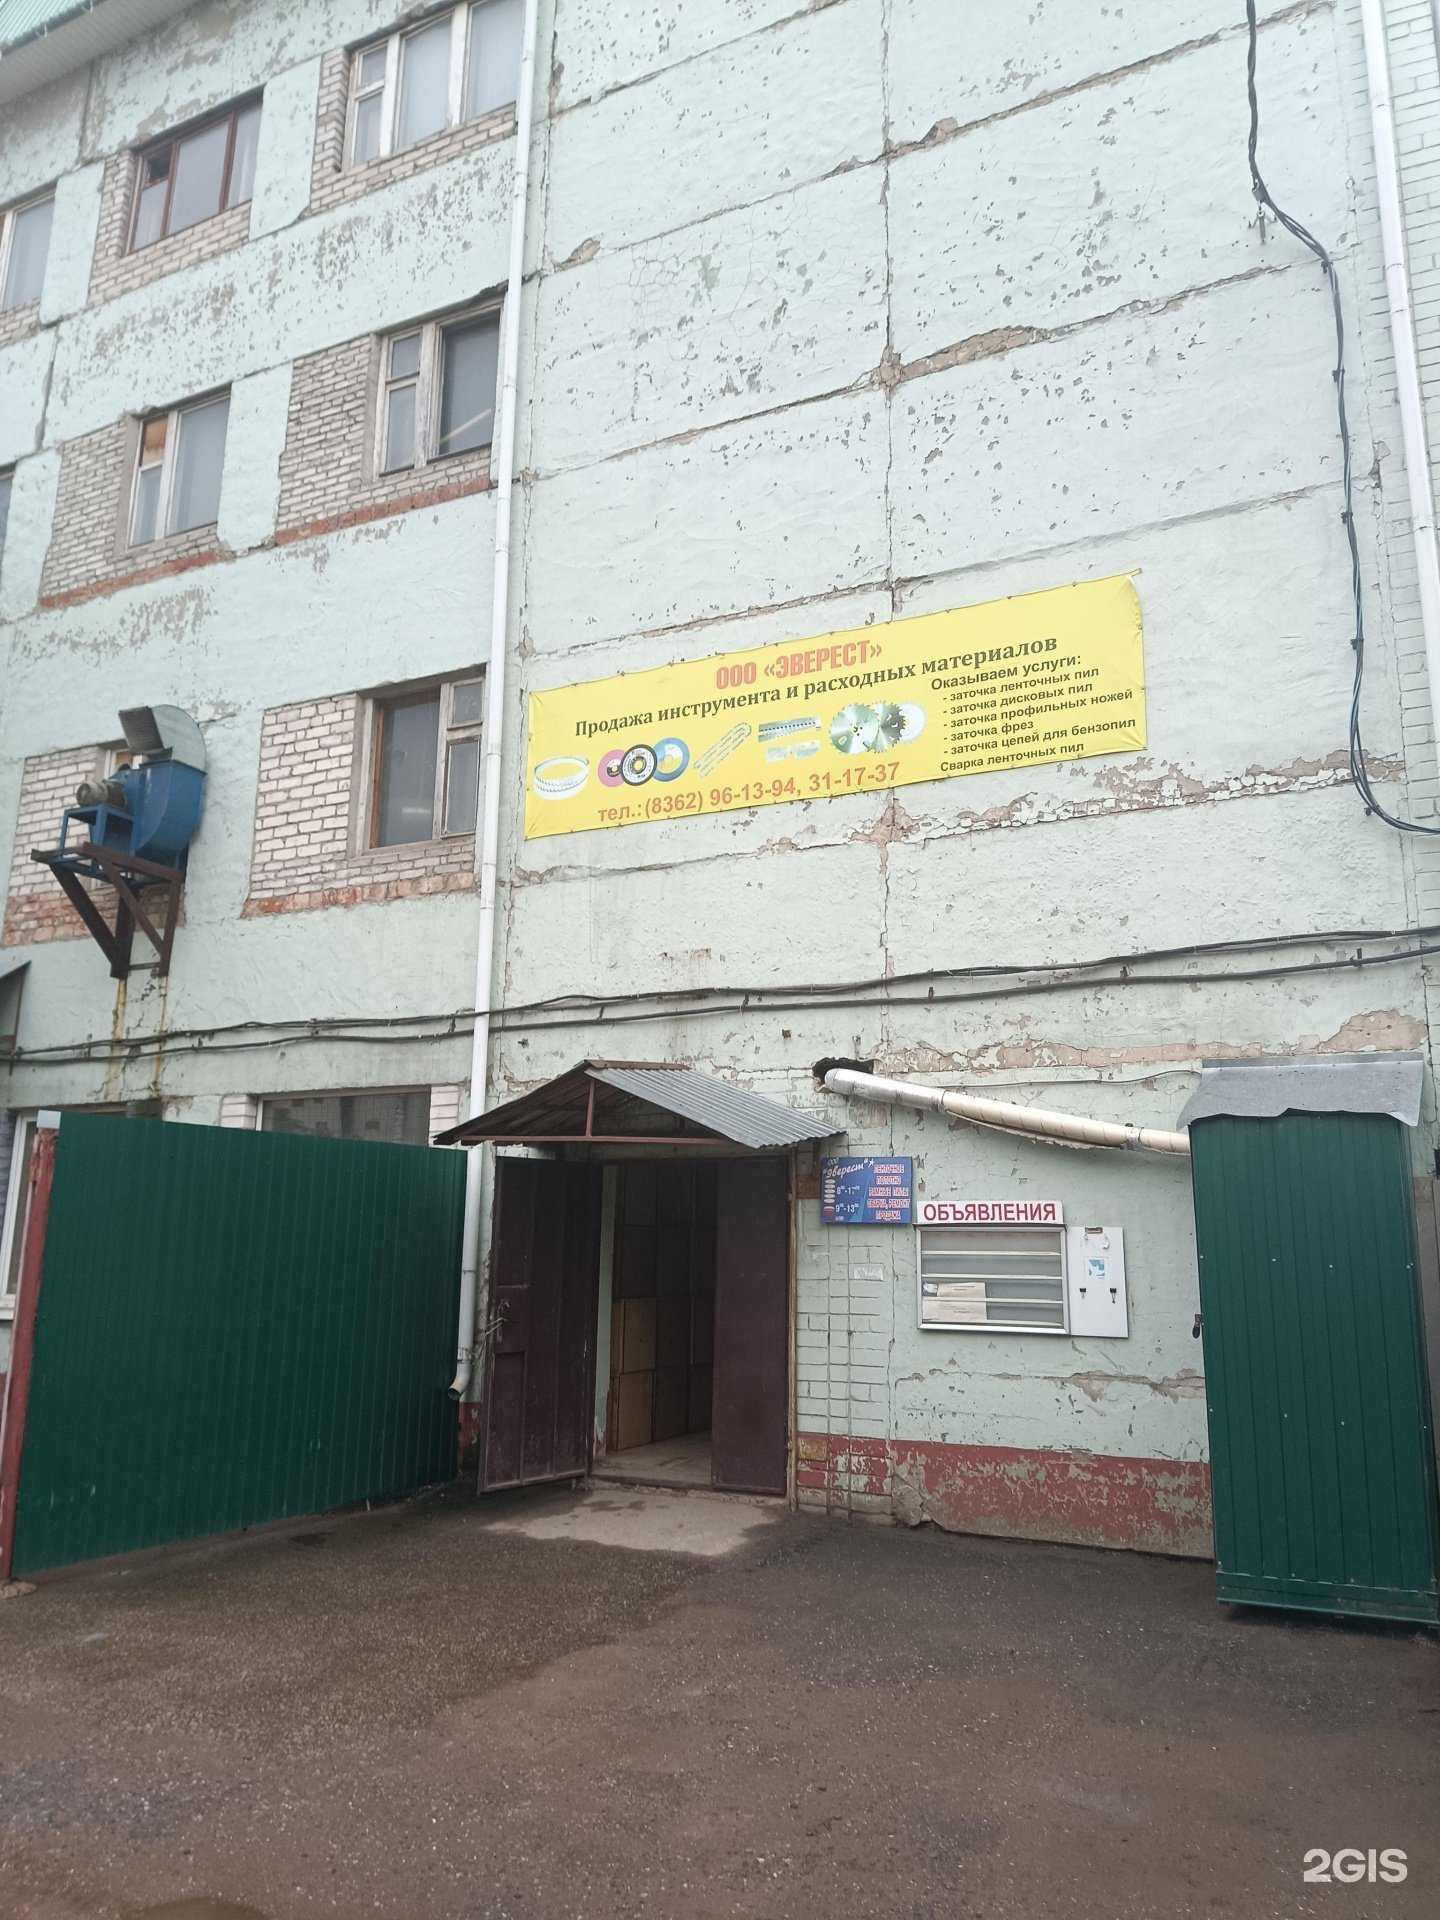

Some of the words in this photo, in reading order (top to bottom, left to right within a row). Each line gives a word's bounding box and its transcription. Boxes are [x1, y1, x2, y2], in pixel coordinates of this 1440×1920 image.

[716, 662, 757, 690] ООО
[764, 640, 882, 679] «ЭВЕРЕСТ»
[931, 666, 1018, 691] Оказываем
[1023, 655, 1082, 679] услуги:
[575, 711, 653, 738] Продажа
[658, 687, 781, 719] инструмента
[787, 686, 799, 700] и
[804, 665, 916, 700] расходных
[922, 638, 1057, 674] материалов
[950, 685, 997, 701] заточка
[1000, 672, 1071, 694] ленточных
[1074, 666, 1099, 680] пил
[950, 699, 997, 715] заточка
[1000, 688, 1064, 708] дисковых
[1068, 682, 1093, 695] пил
[950, 713, 997, 729] заточка
[1001, 698, 1087, 723] профильных
[1091, 688, 1133, 708] ножей
[950, 727, 998, 742] заточка
[1001, 719, 1034, 738] фрез
[951, 740, 998, 755] заточка
[1002, 731, 1040, 750] цепей
[1043, 728, 1067, 744] для
[1071, 718, 1136, 737] бензопил
[940, 755, 984, 773] Сварка
[987, 743, 1056, 766] ленточных
[1060, 742, 1085, 755] пил
[710, 777, 801, 807] 96-13-94,
[808, 762, 900, 793] 31-17-37
[923, 1203, 1056, 1221] ОБЪЯВЛЕНИЯ
